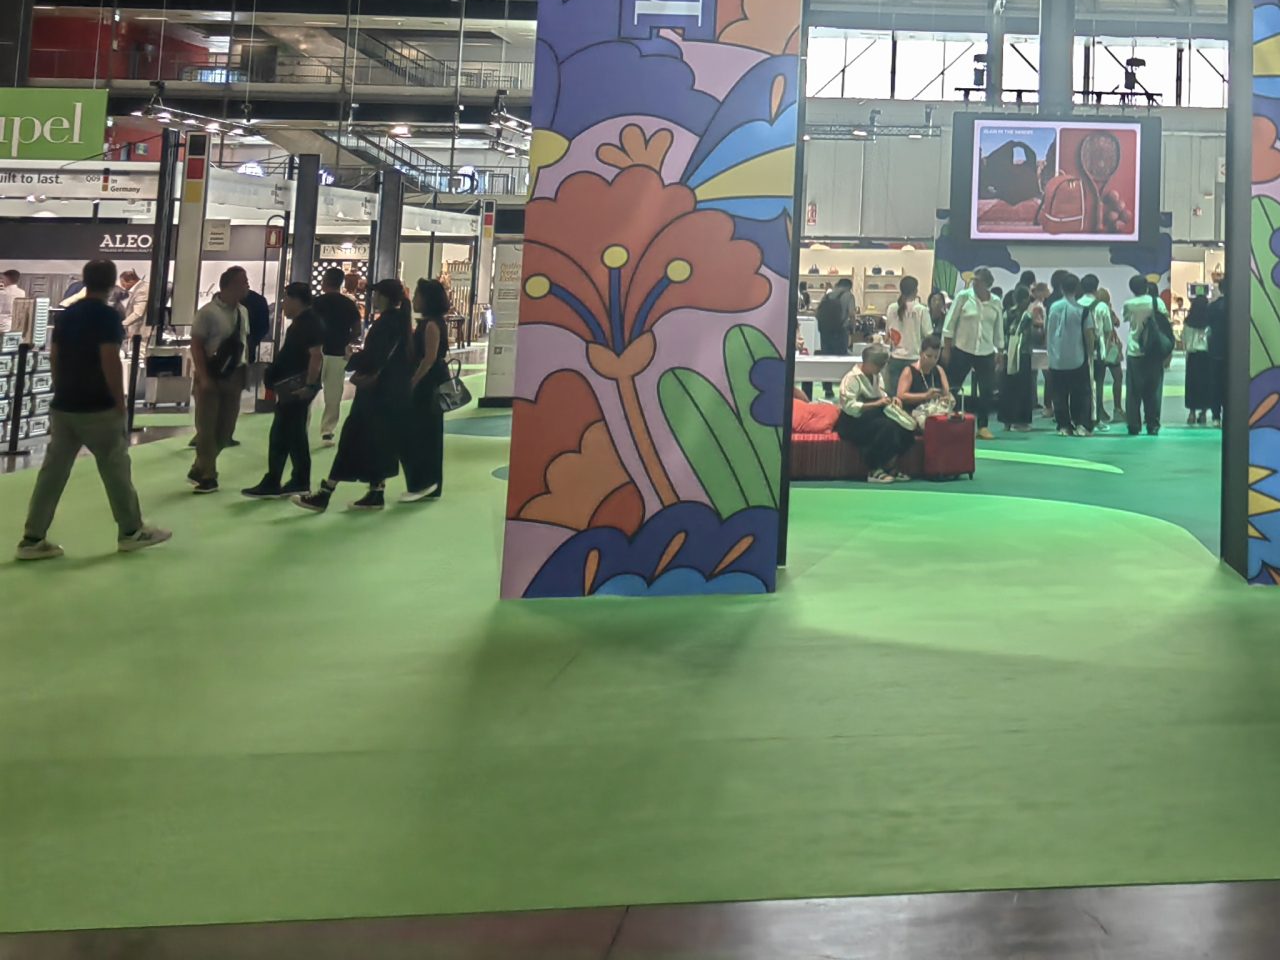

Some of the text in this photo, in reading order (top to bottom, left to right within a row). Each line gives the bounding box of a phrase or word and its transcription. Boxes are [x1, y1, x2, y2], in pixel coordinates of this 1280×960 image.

[20, 174, 34, 184] to
[110, 185, 141, 193] Germany
[99, 234, 153, 248] ALEO
